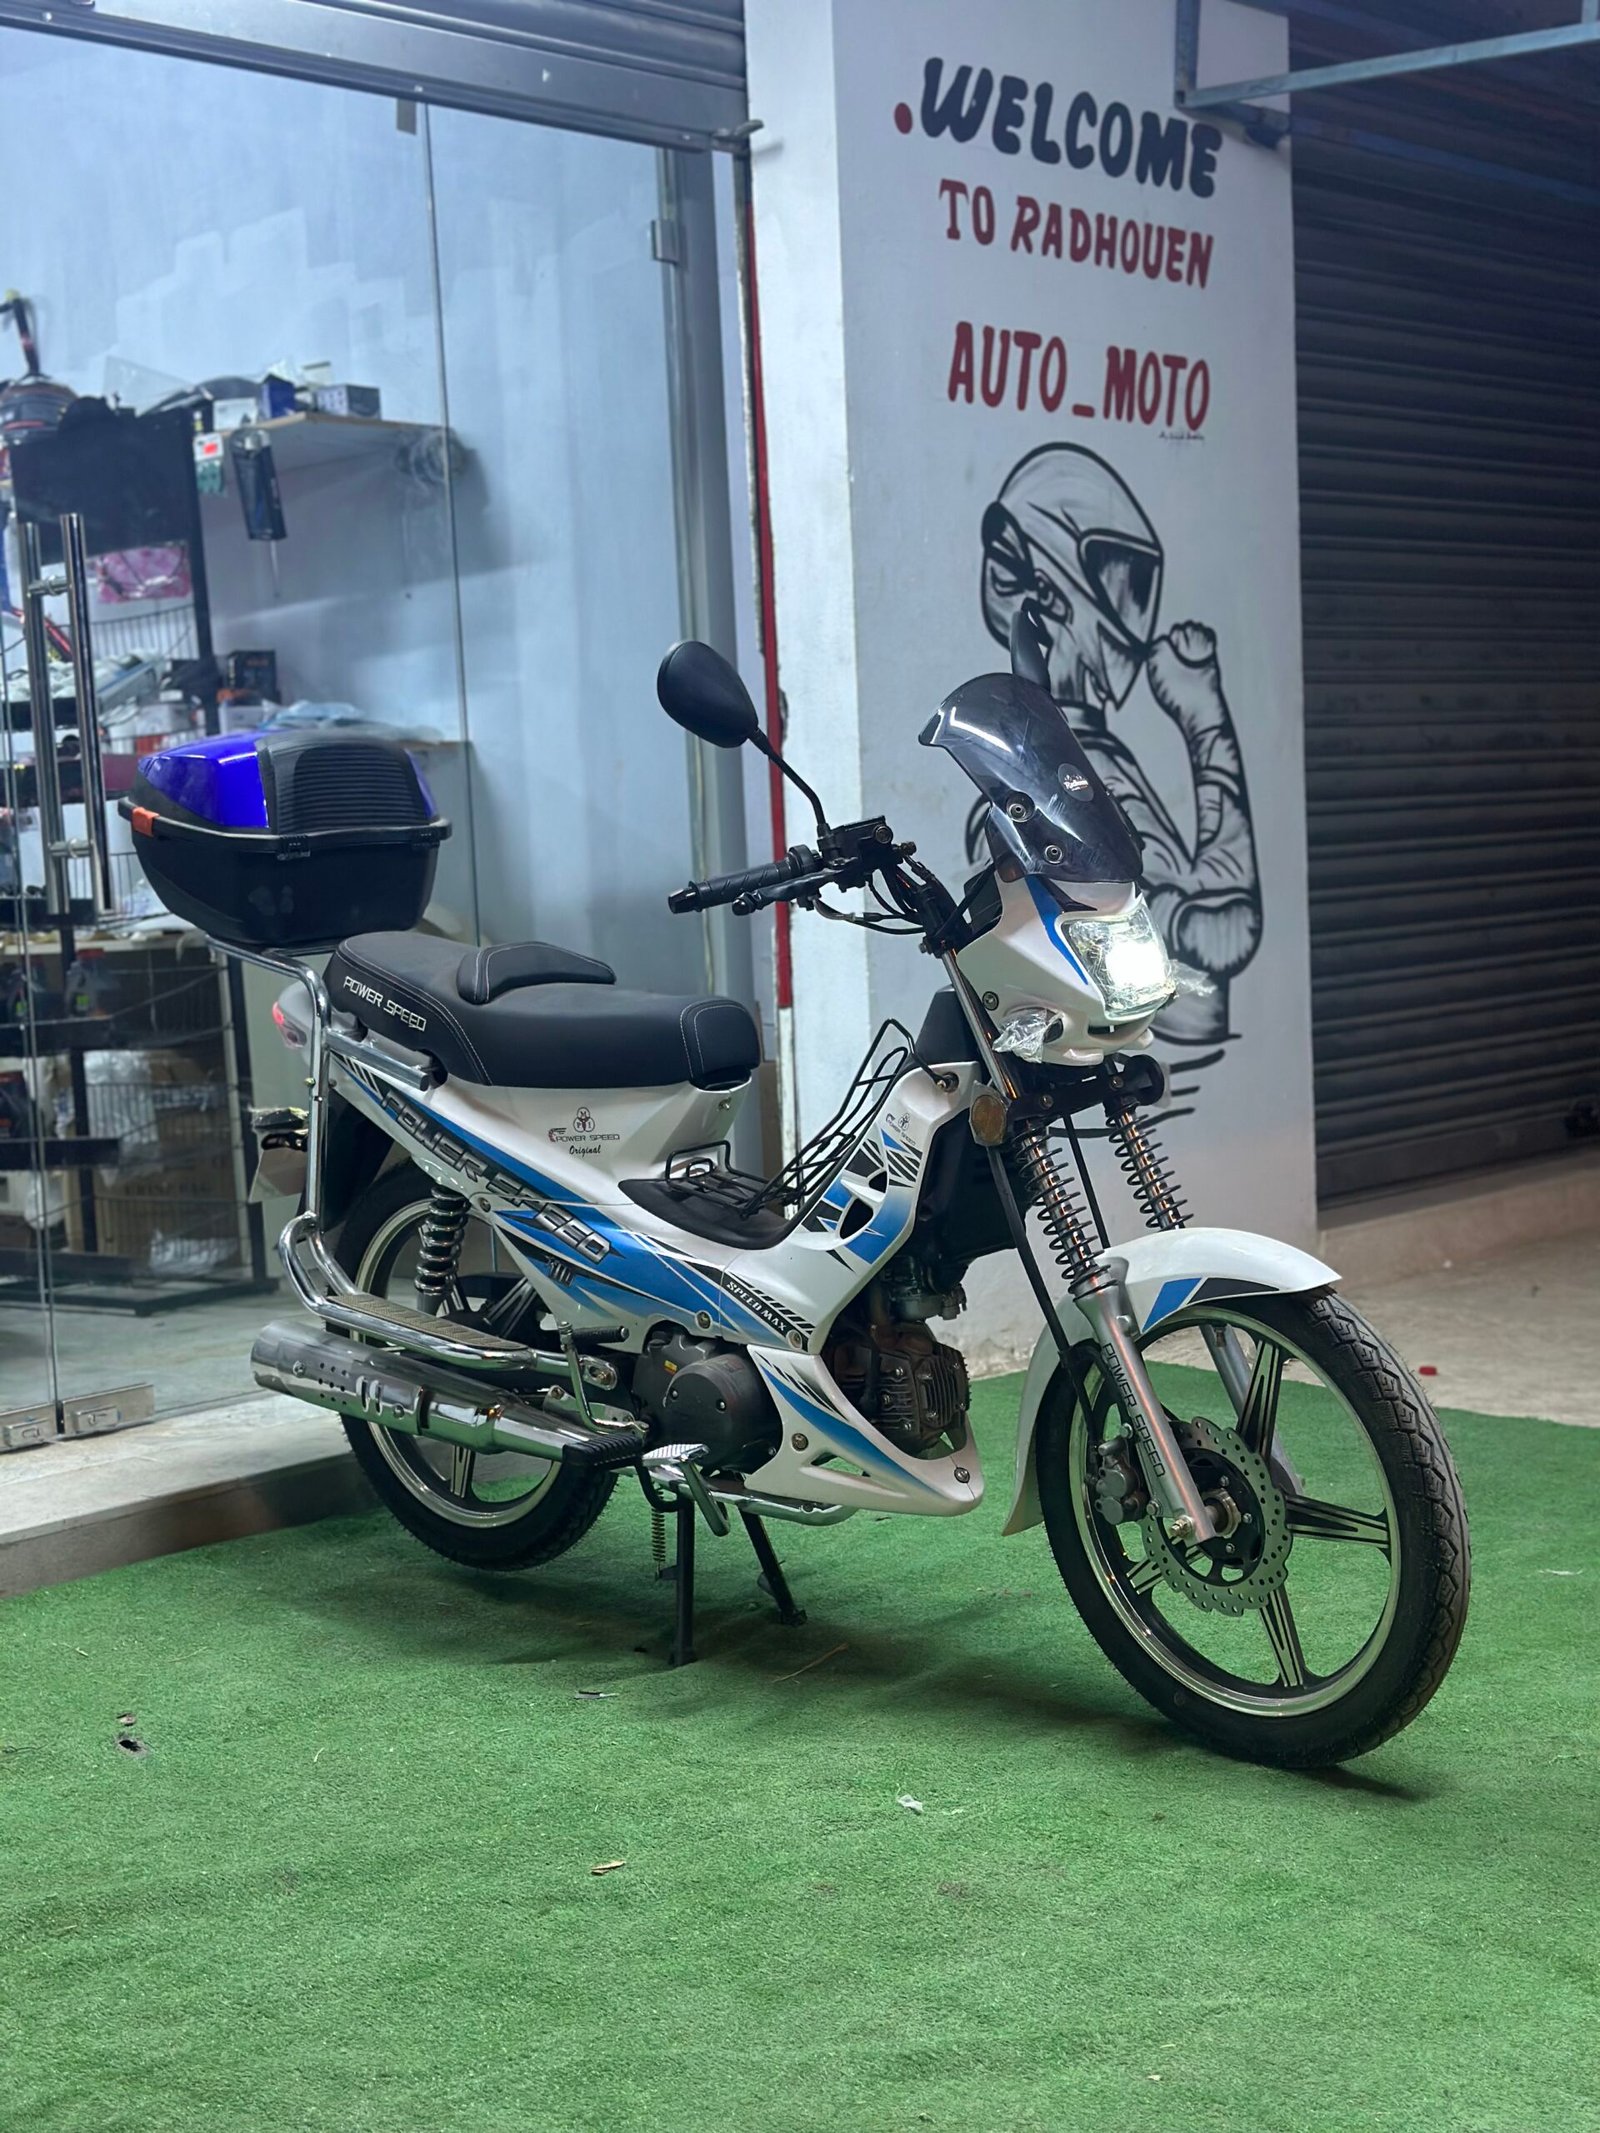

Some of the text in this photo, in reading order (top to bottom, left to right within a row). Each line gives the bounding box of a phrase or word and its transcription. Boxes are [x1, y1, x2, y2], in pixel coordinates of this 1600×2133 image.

[938, 178, 1214, 290] TO RADHOUEN
[343, 975, 427, 1033] POWER SPEED
[555, 1133, 620, 1143] POWER SPEED
[568, 1144, 602, 1158] Original
[381, 1089, 612, 1265] POWER SPEED
[726, 1281, 787, 1331] SPEED MAX
[1102, 1343, 1166, 1478] POWER SPEED
